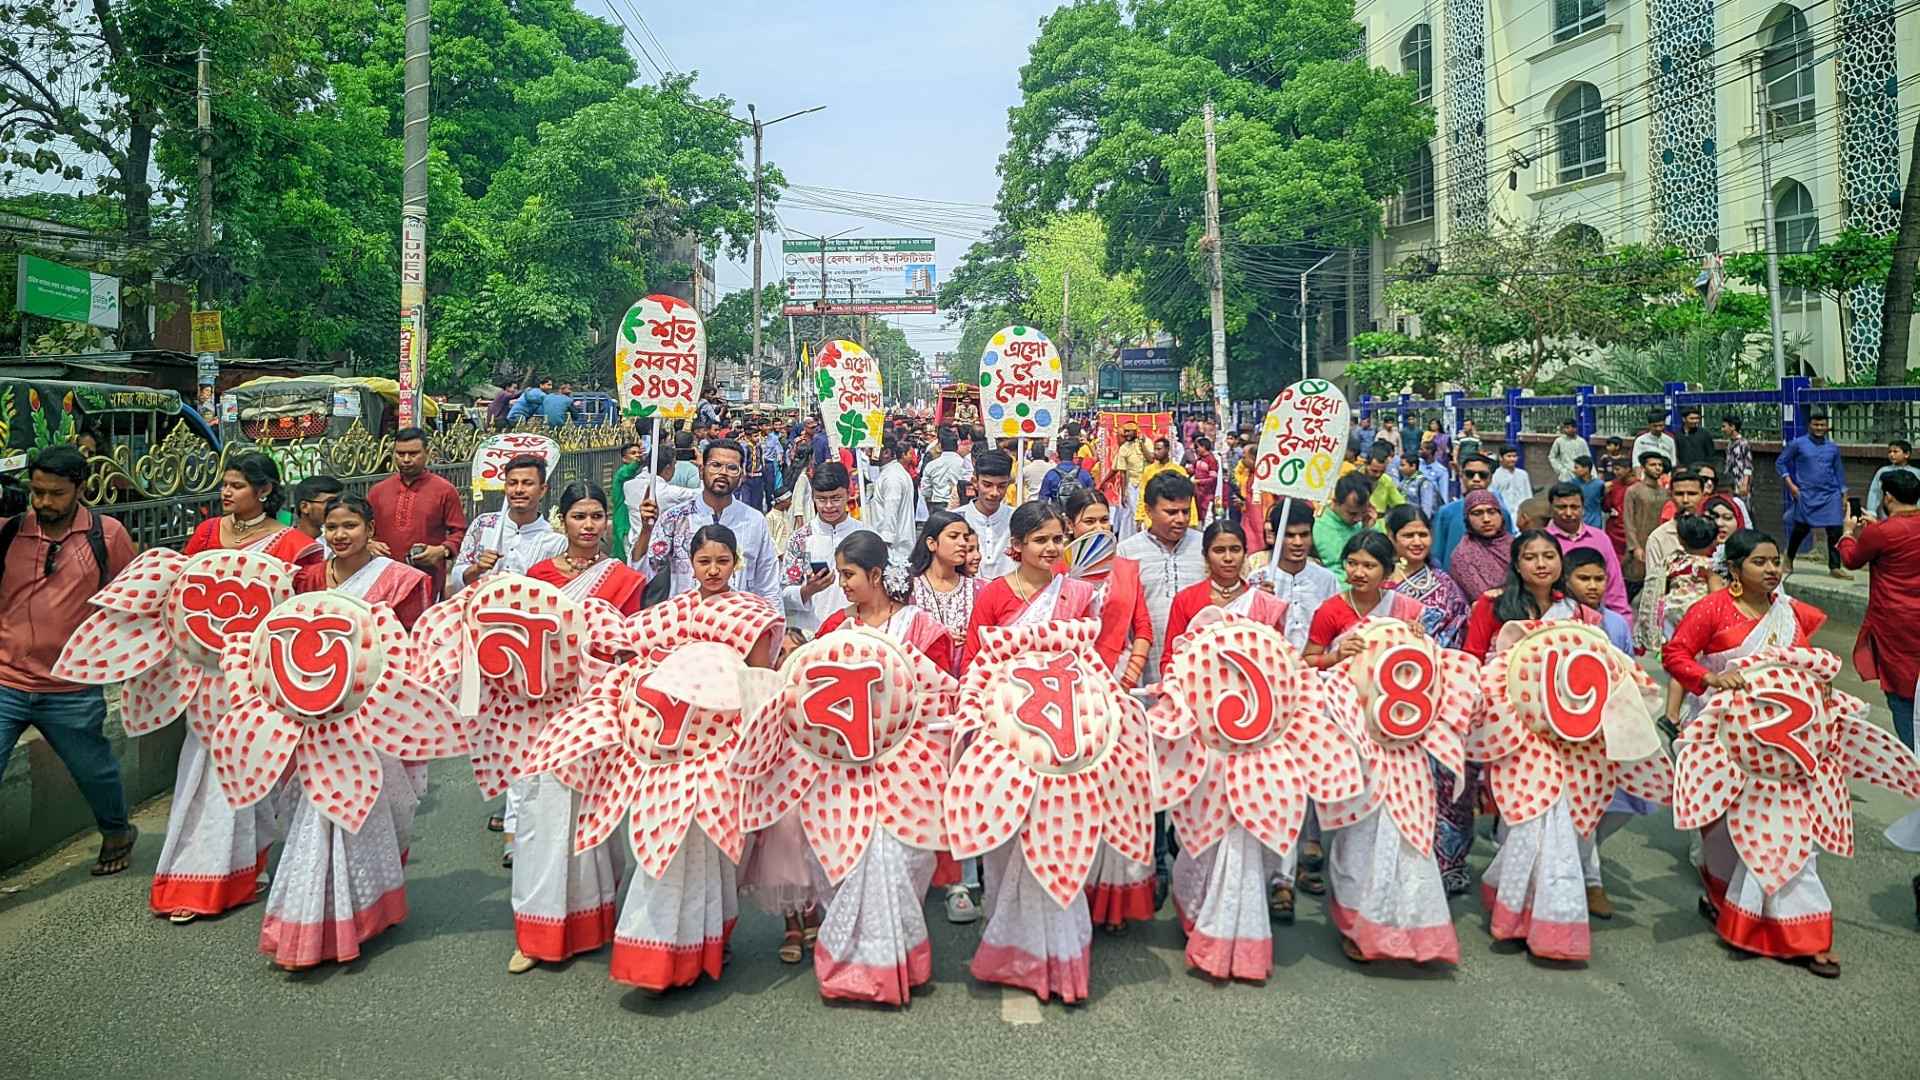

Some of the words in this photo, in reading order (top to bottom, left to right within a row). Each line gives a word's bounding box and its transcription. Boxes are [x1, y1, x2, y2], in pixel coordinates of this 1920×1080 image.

[404, 230, 421, 281] LUMEN
[648, 315, 697, 349] শুভ
[634, 344, 698, 378] নববর্ষ
[842, 357, 872, 374] এসো
[1004, 341, 1049, 362] এসো
[631, 373, 694, 402] ১৪৩২
[849, 374, 868, 392] হে
[996, 368, 1062, 404] বৈশাখ
[1010, 360, 1042, 382] হে
[838, 376, 882, 412] বৈশাখ
[1293, 395, 1343, 417] এসো
[1275, 416, 1340, 457] বৈশাখ
[1302, 417, 1331, 436] হে
[267, 614, 352, 713] ভ
[476, 611, 560, 698] ন
[1214, 648, 1275, 742] ১
[1376, 645, 1435, 740] ৪
[1541, 648, 1610, 742] ৩
[802, 663, 883, 760] ব
[1750, 689, 1818, 776] ২
